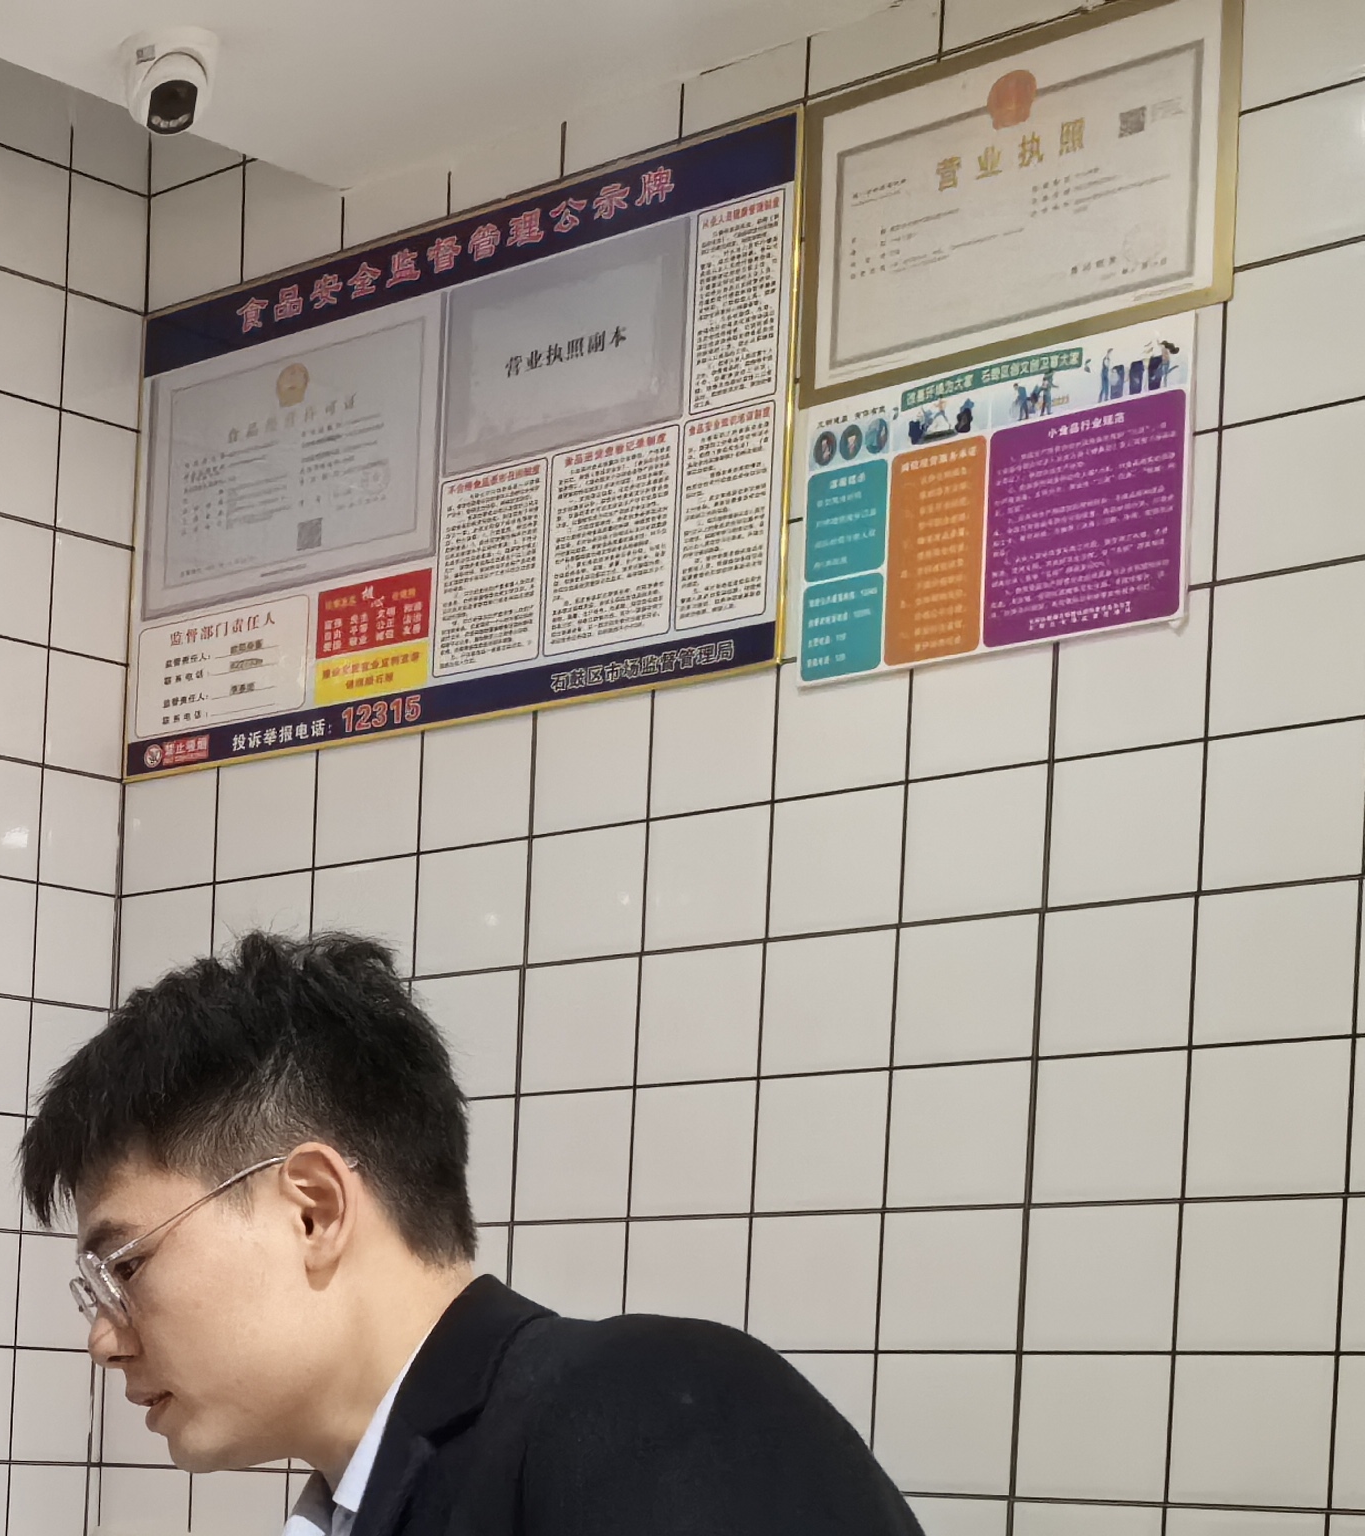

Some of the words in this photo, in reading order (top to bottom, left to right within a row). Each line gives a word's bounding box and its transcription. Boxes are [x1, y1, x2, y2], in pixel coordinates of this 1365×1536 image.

[936, 117, 1085, 192] 营业执照
[236, 166, 676, 333] 食品安全监督管理公示牌
[505, 325, 626, 378] 营业执照副本
[170, 611, 275, 646] 监督部门责任人
[550, 639, 734, 693] 石鼓区市场监督管理局
[231, 718, 332, 752] 投诉举报电话：
[341, 694, 423, 733] 12315
